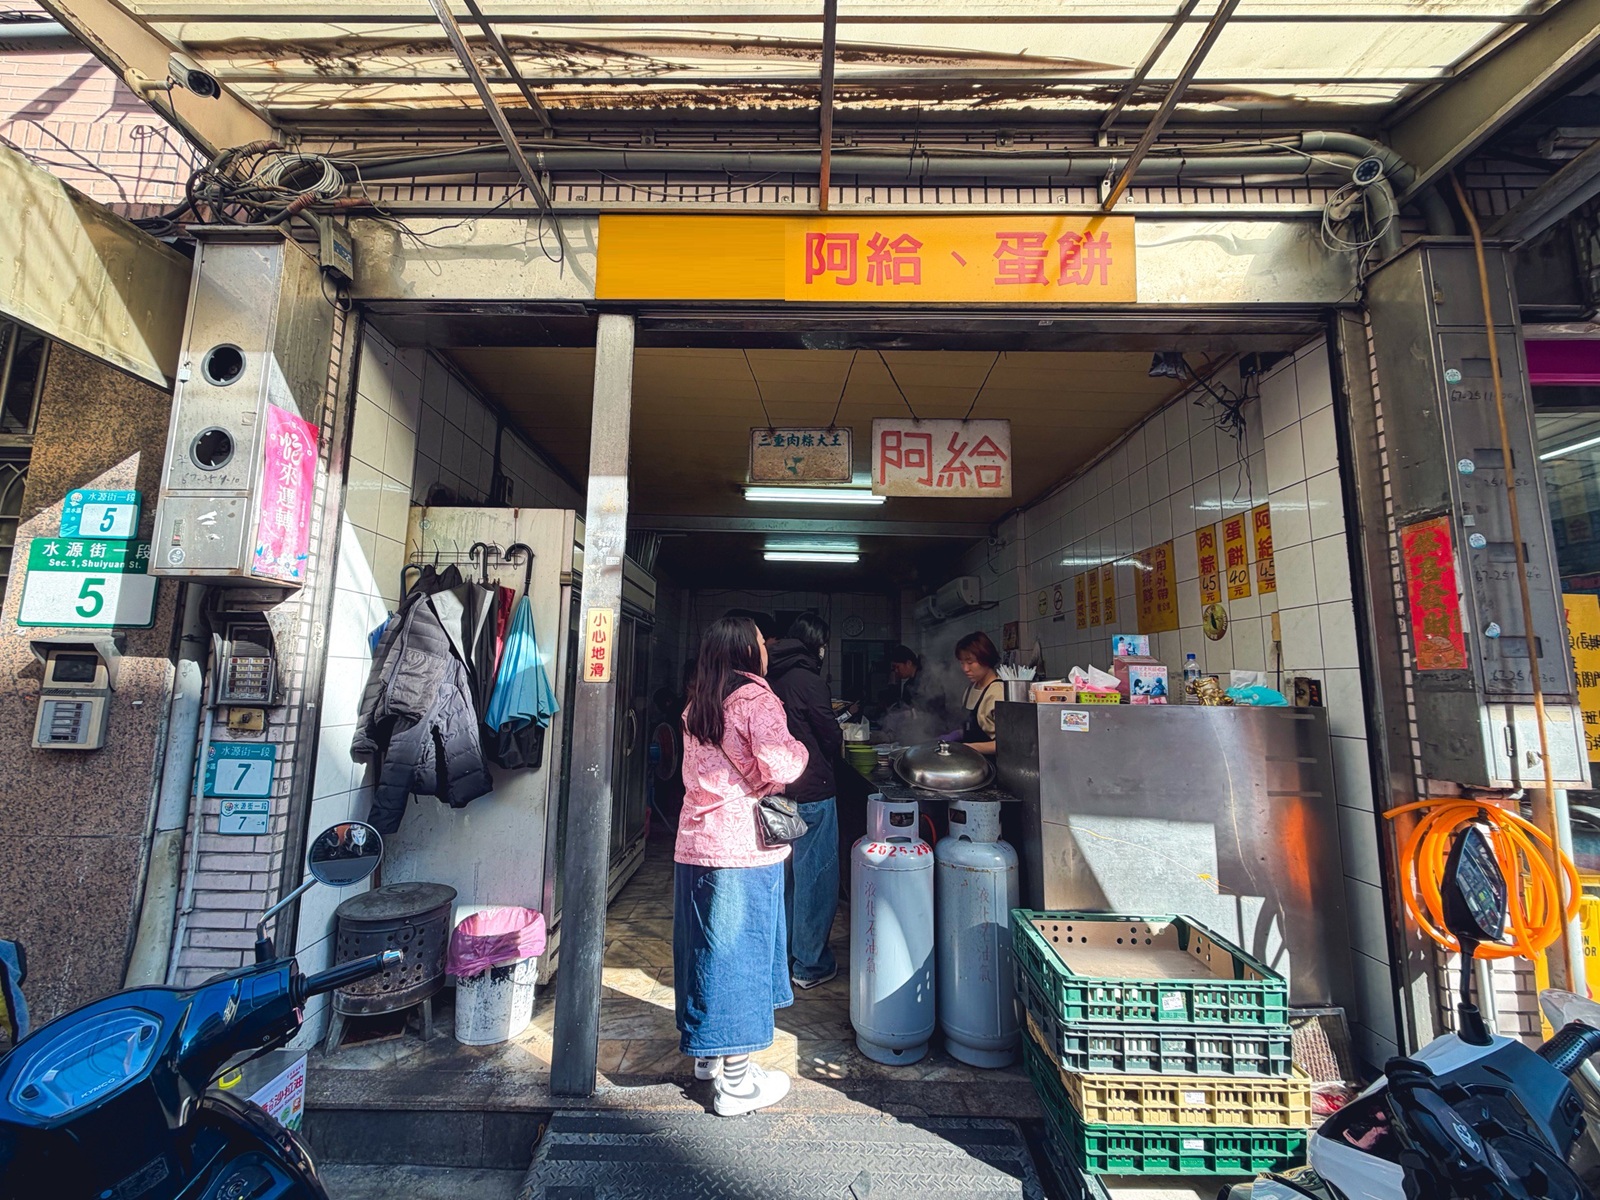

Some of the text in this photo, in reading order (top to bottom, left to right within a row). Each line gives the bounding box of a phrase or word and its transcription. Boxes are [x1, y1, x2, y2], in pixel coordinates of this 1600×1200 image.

[805, 231, 1113, 287] 阿給、蛋餅
[757, 433, 842, 448] 三重肉粽大王
[879, 430, 1008, 489] 阿給
[88, 492, 136, 502] 水源街一段
[99, 507, 117, 532] 5
[42, 541, 150, 560] 水源街一段
[1199, 532, 1216, 575] 肉粽
[1225, 519, 1244, 568] 蛋餅
[81, 560, 125, 570] Shuiyuan
[128, 560, 142, 569] St.
[1229, 569, 1247, 585] 40
[1202, 574, 1216, 591] 45
[1412, 531, 1450, 638] 恭喜發財
[75, 577, 106, 618] 5
[590, 612, 607, 677] 小心地滑
[221, 746, 270, 757] 水源街一段
[233, 763, 252, 791] 7
[238, 816, 247, 830] 7
[865, 881, 878, 974] 液化石油氣
[81, 1077, 116, 1098] KYMCO
